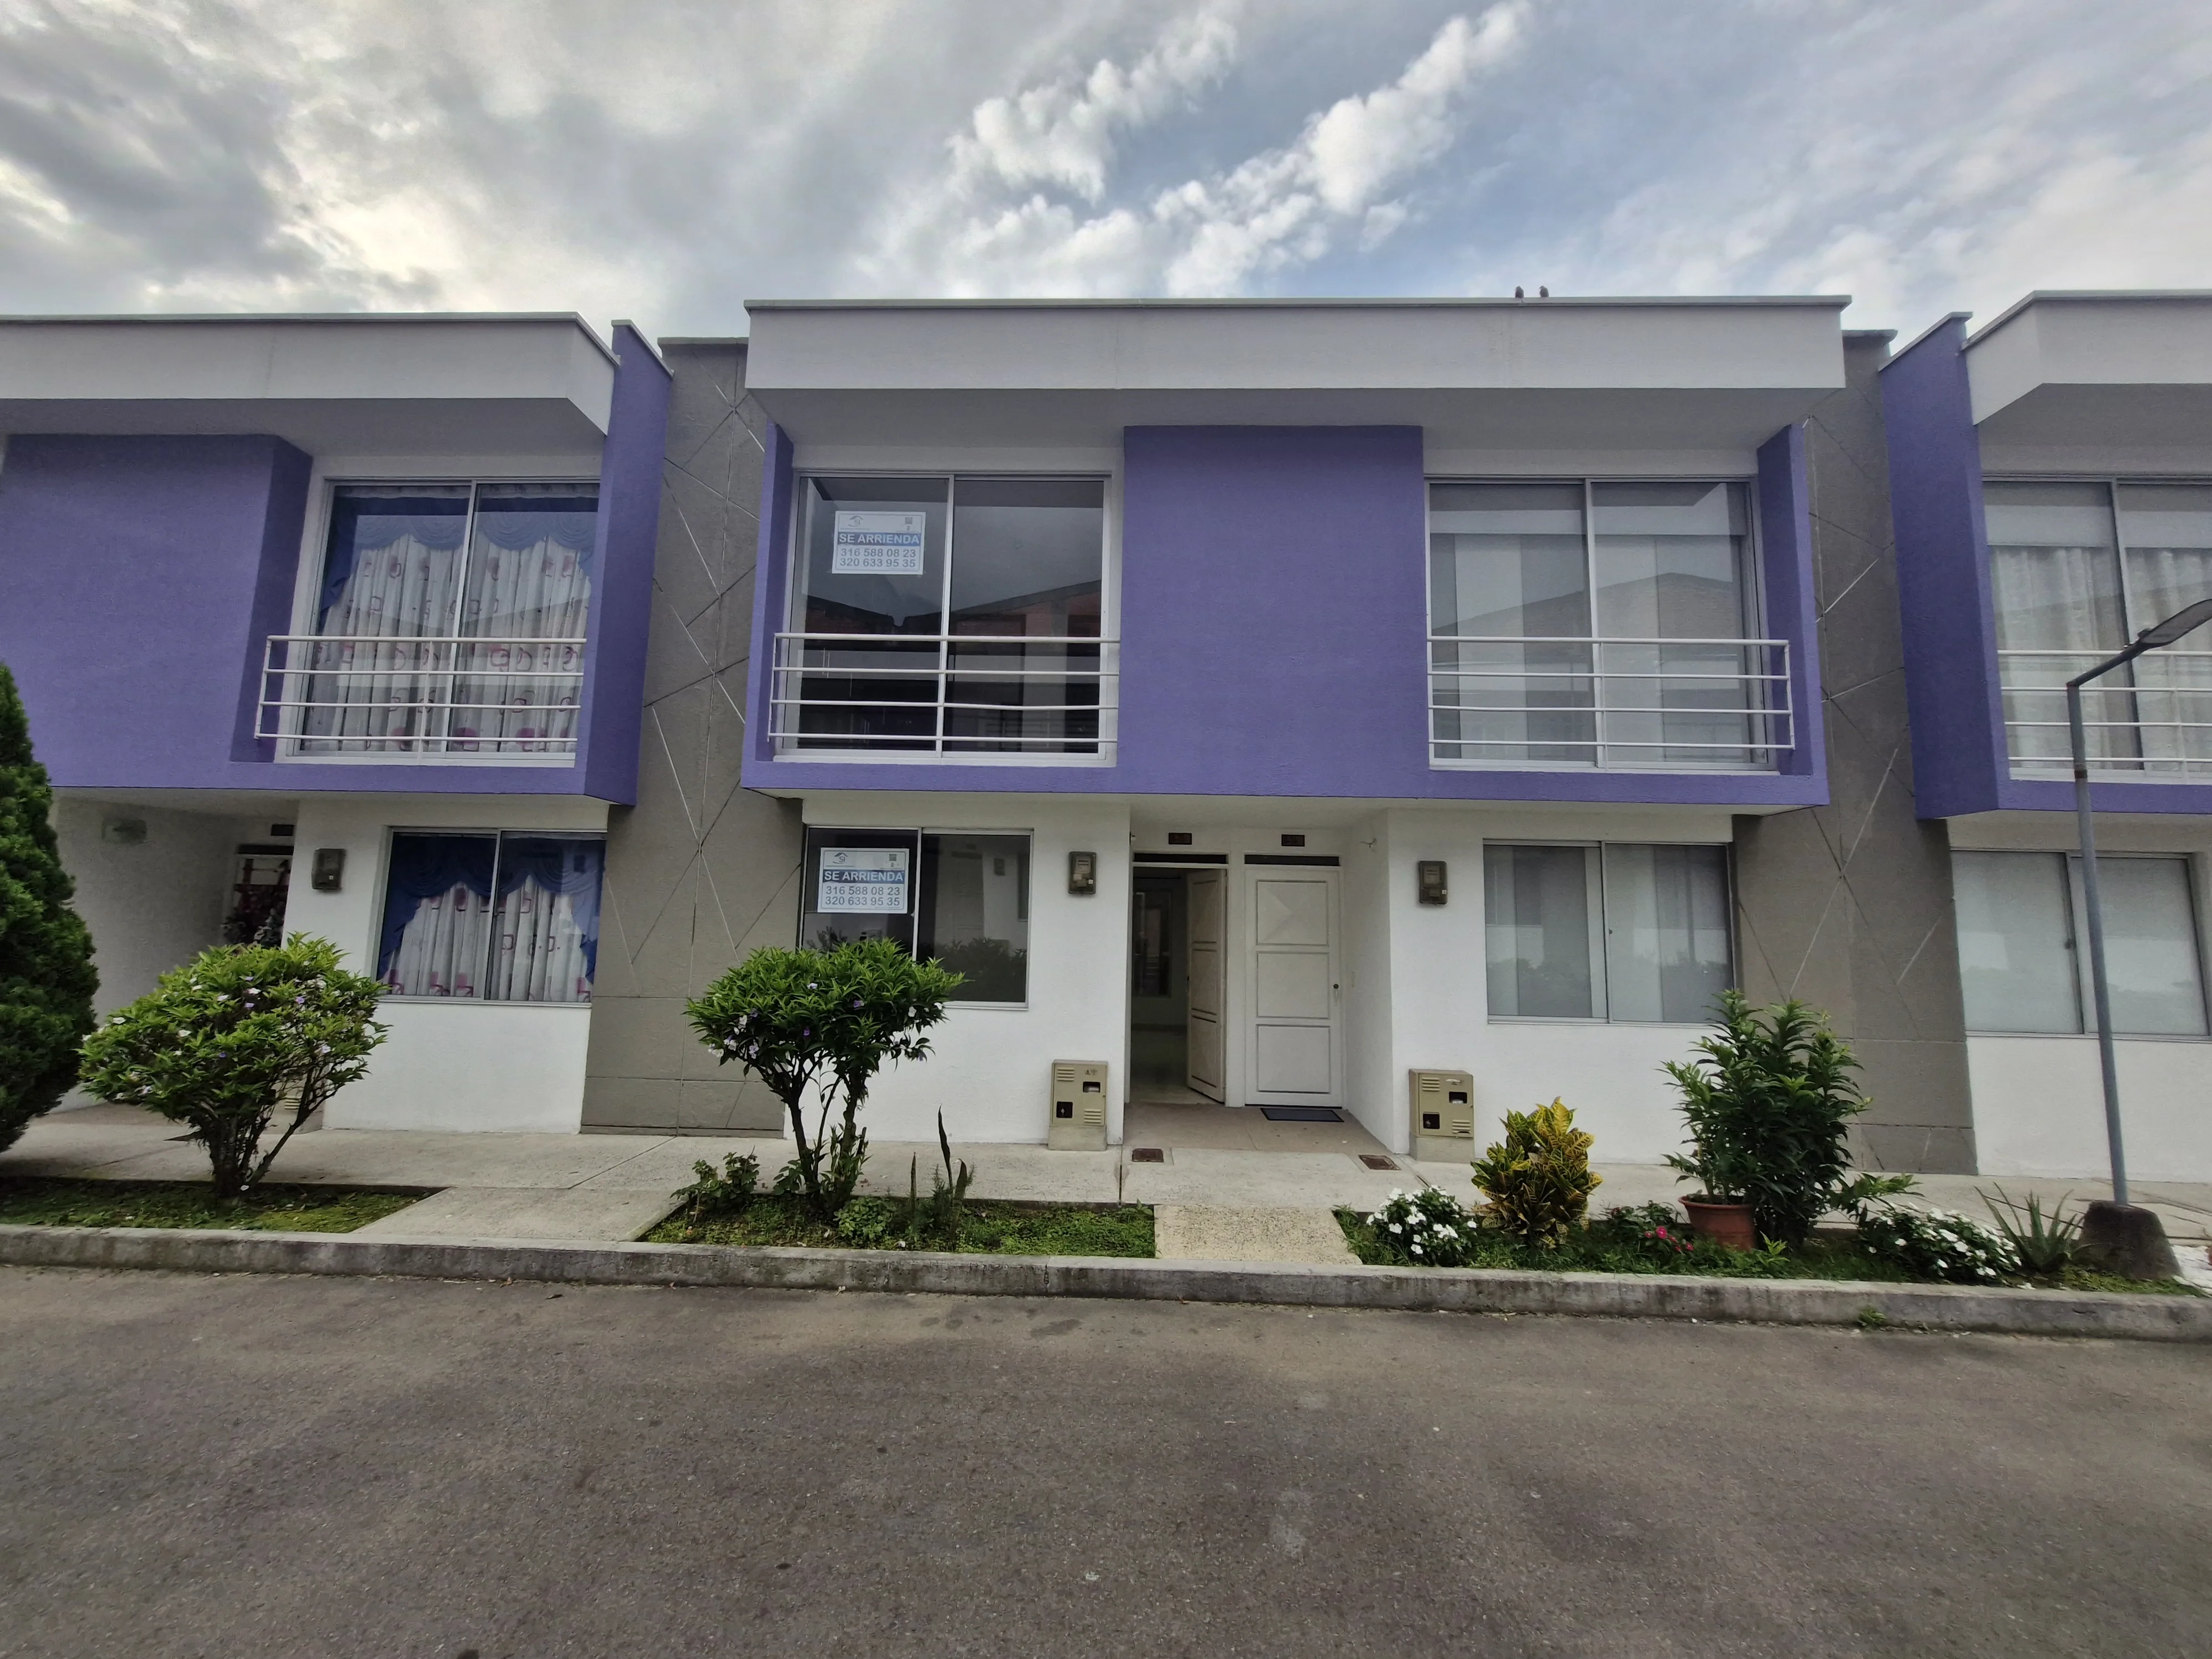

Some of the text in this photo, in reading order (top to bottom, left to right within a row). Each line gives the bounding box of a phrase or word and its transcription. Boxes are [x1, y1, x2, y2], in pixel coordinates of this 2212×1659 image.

[839, 534, 919, 544] SE ARRIENDA
[841, 548, 916, 557] 316 588 08 23
[840, 558, 916, 567] 320 633 95 35
[824, 871, 903, 881] SE ARRIENDA
[826, 886, 900, 895] 316 588 08 23
[825, 896, 900, 906] 320 633 95 35
